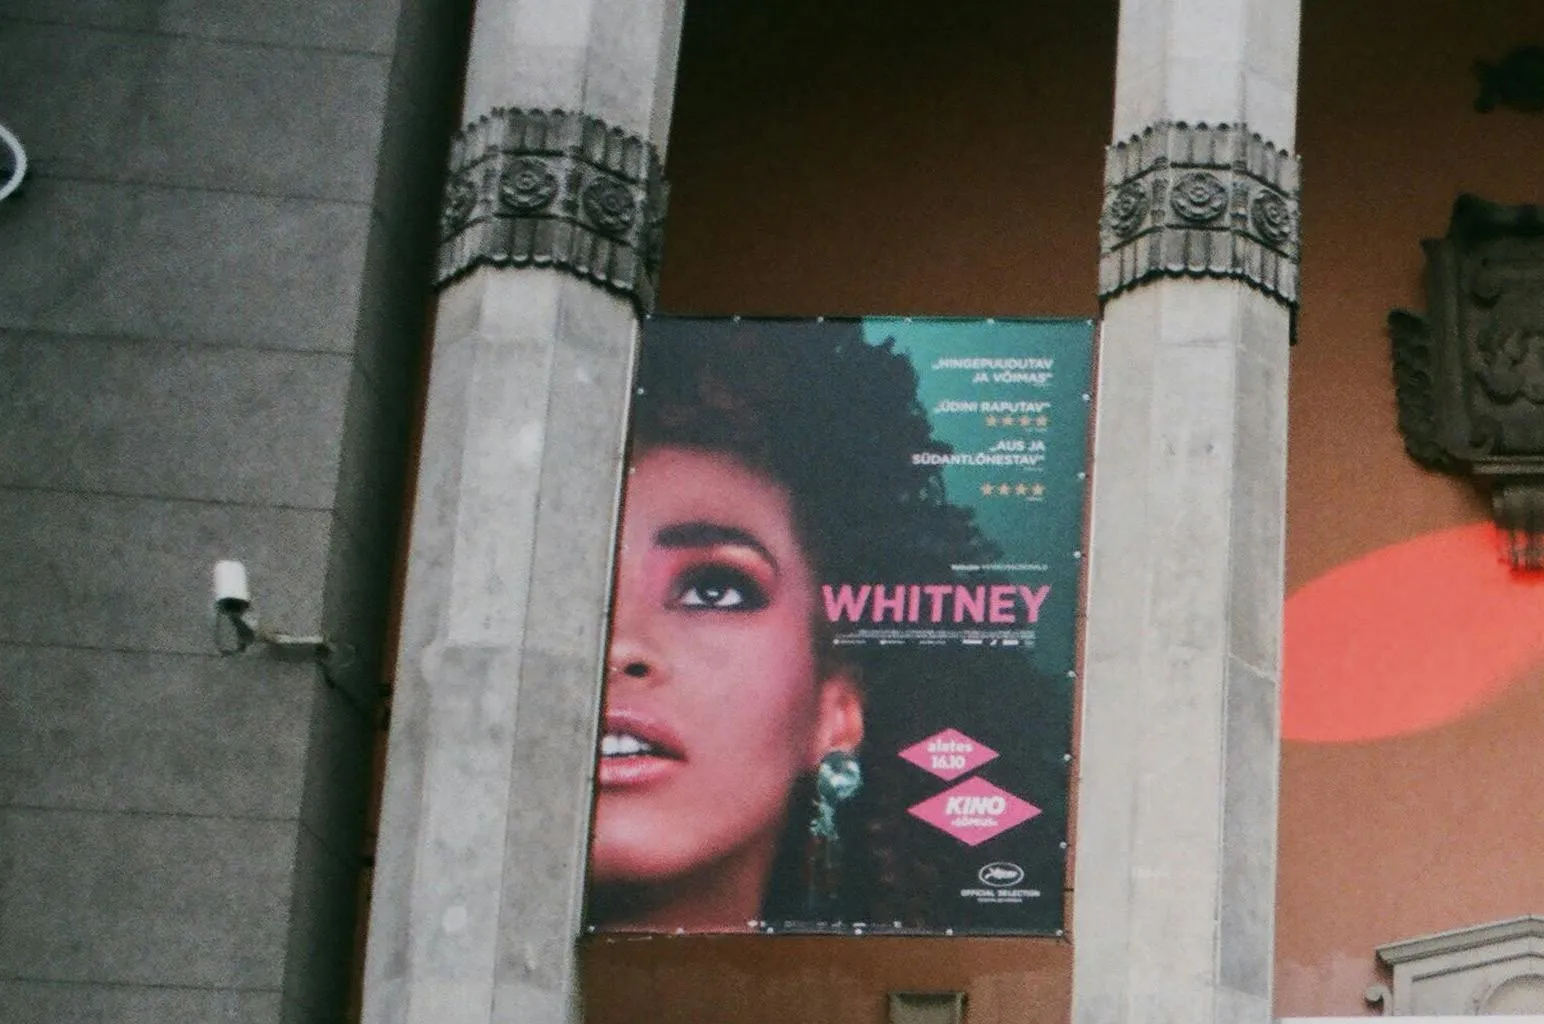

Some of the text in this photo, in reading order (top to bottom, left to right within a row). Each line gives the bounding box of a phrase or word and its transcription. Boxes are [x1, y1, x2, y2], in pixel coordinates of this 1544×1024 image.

[1028, 440, 1045, 451] JA
[822, 584, 1051, 623] WHITNEY
[927, 739, 973, 752] alates
[945, 796, 1006, 815] KINO
[961, 888, 1041, 897] OFFICIAL SELECTION
